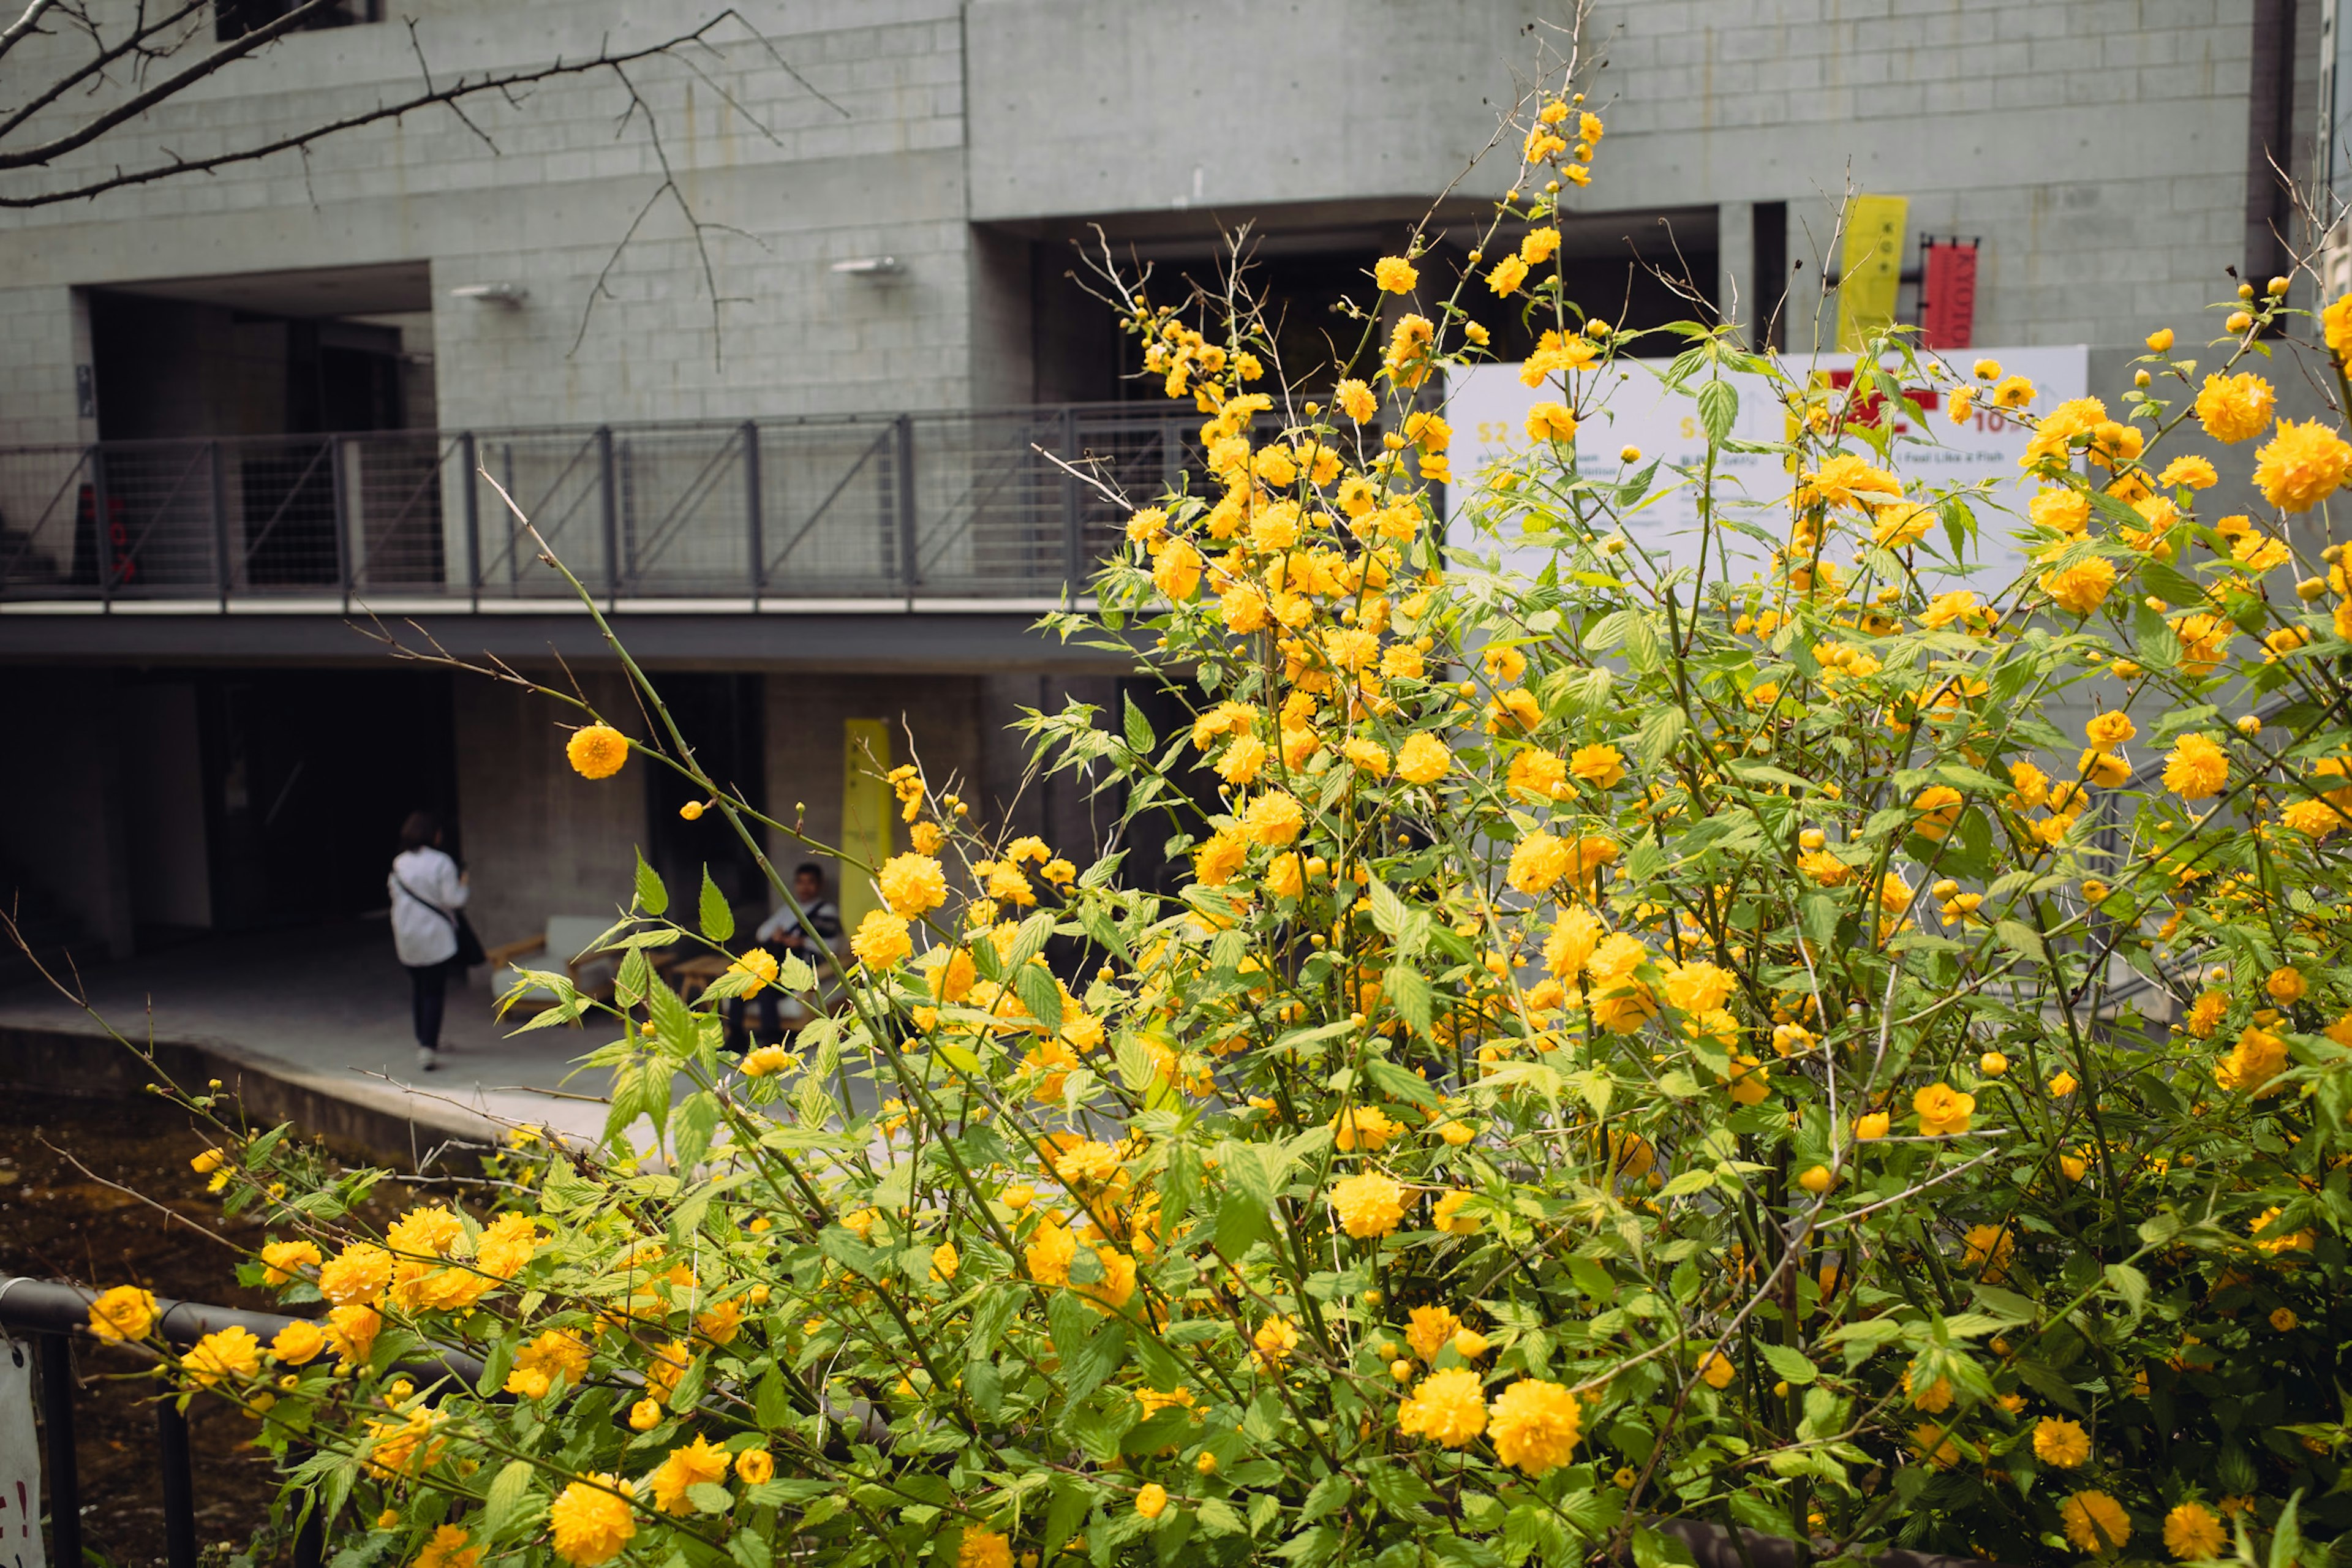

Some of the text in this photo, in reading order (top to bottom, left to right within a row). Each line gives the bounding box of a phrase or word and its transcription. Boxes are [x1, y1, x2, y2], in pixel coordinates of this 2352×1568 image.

[1950, 253, 1976, 349] KYOTO
[1973, 411, 2005, 432] 10
[1934, 451, 1961, 463] Like
[1976, 450, 2005, 462] Fish
